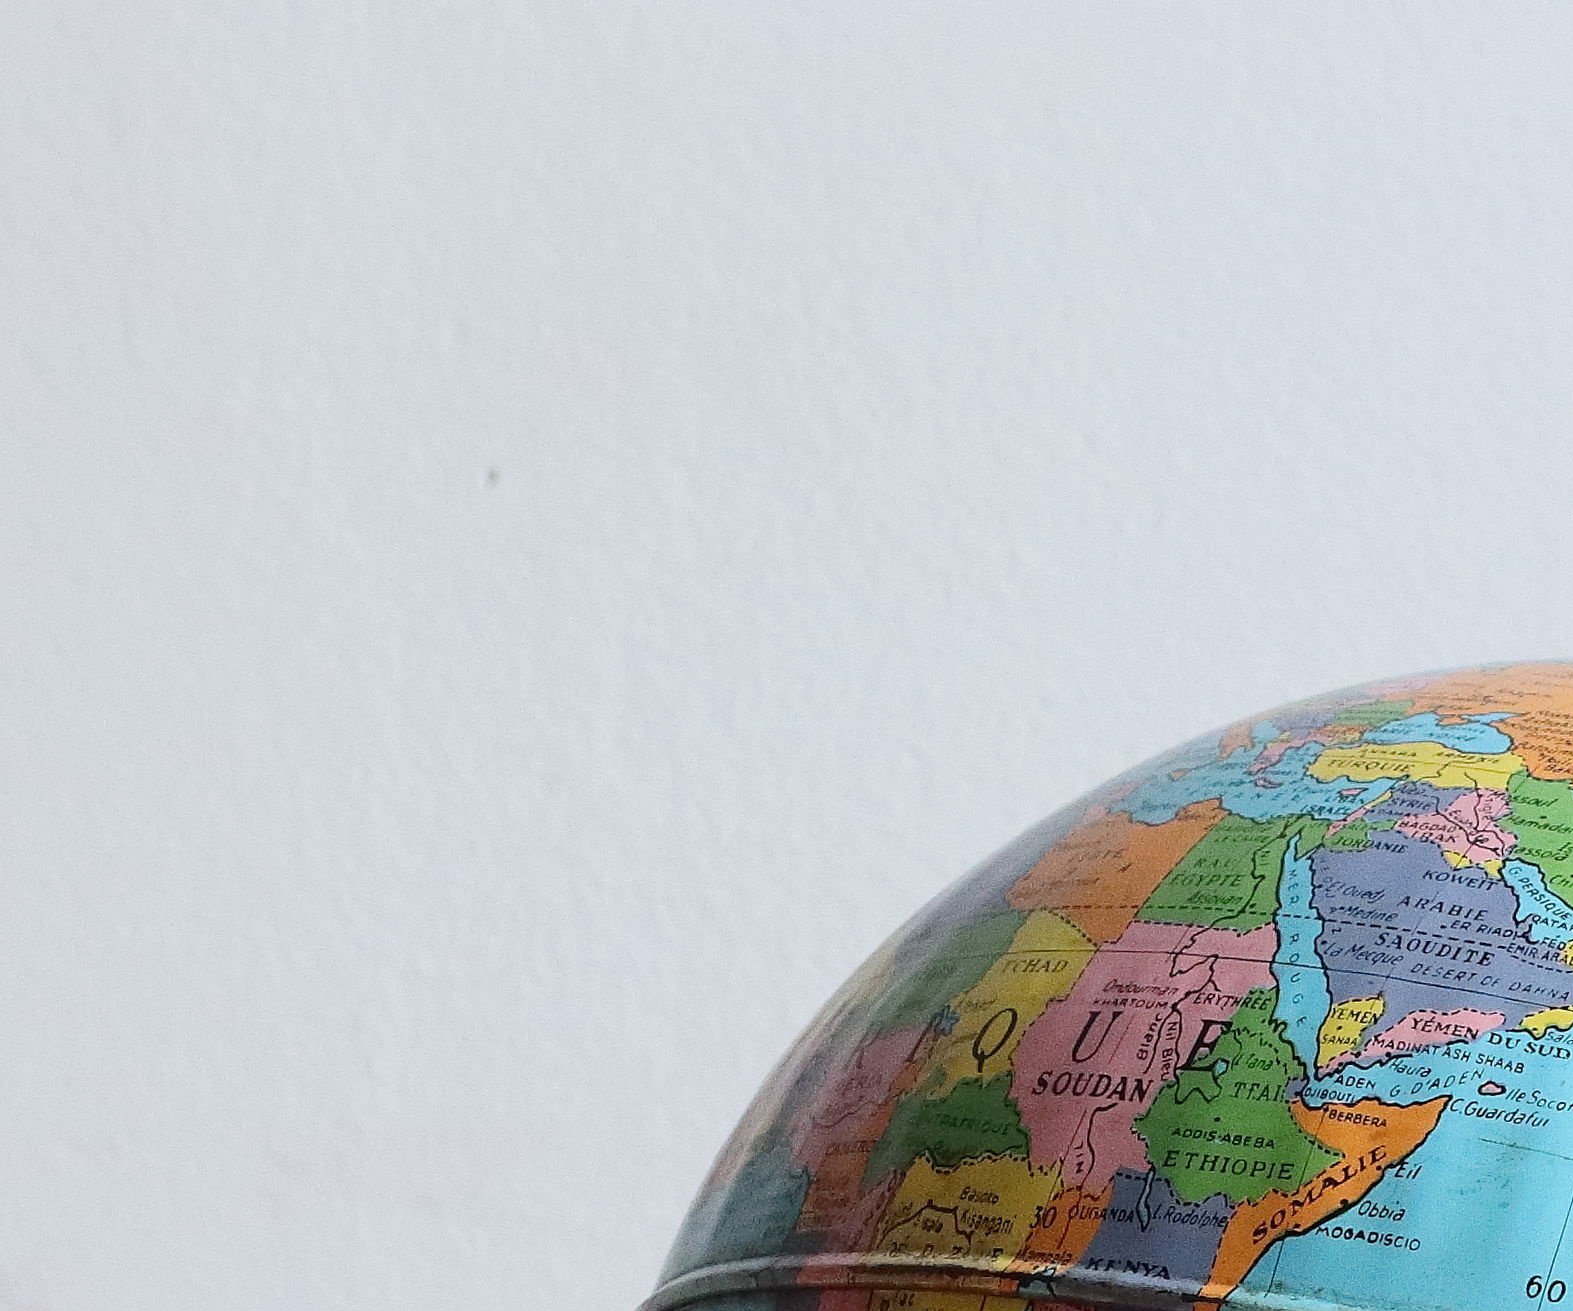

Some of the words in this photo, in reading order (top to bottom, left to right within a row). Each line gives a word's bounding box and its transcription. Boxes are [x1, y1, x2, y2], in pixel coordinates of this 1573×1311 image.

[1422, 869, 1499, 891] KOWEIT
[1399, 896, 1488, 920] ARABIE
[1373, 932, 1495, 967] SAOUDITE
[1411, 1017, 1478, 1040] YÉMEN
[1488, 1032, 1521, 1048] DU
[1523, 1037, 1571, 1060] SUD
[1372, 1036, 1439, 1056] MADINAT
[1442, 1046, 1470, 1061] ASH
[1477, 1054, 1523, 1073] SHAAB
[1032, 1069, 1153, 1103] SOUDAN
[1334, 1075, 1376, 1089] ADEN
[1328, 1109, 1387, 1128] BERBERA
[1162, 1150, 1294, 1180] ETHIOPIE
[1394, 1162, 1422, 1179] Eil
[1252, 1145, 1387, 1244] SOMALIE
[1357, 1201, 1406, 1220] Obbia
[1525, 1275, 1566, 1301] 60
